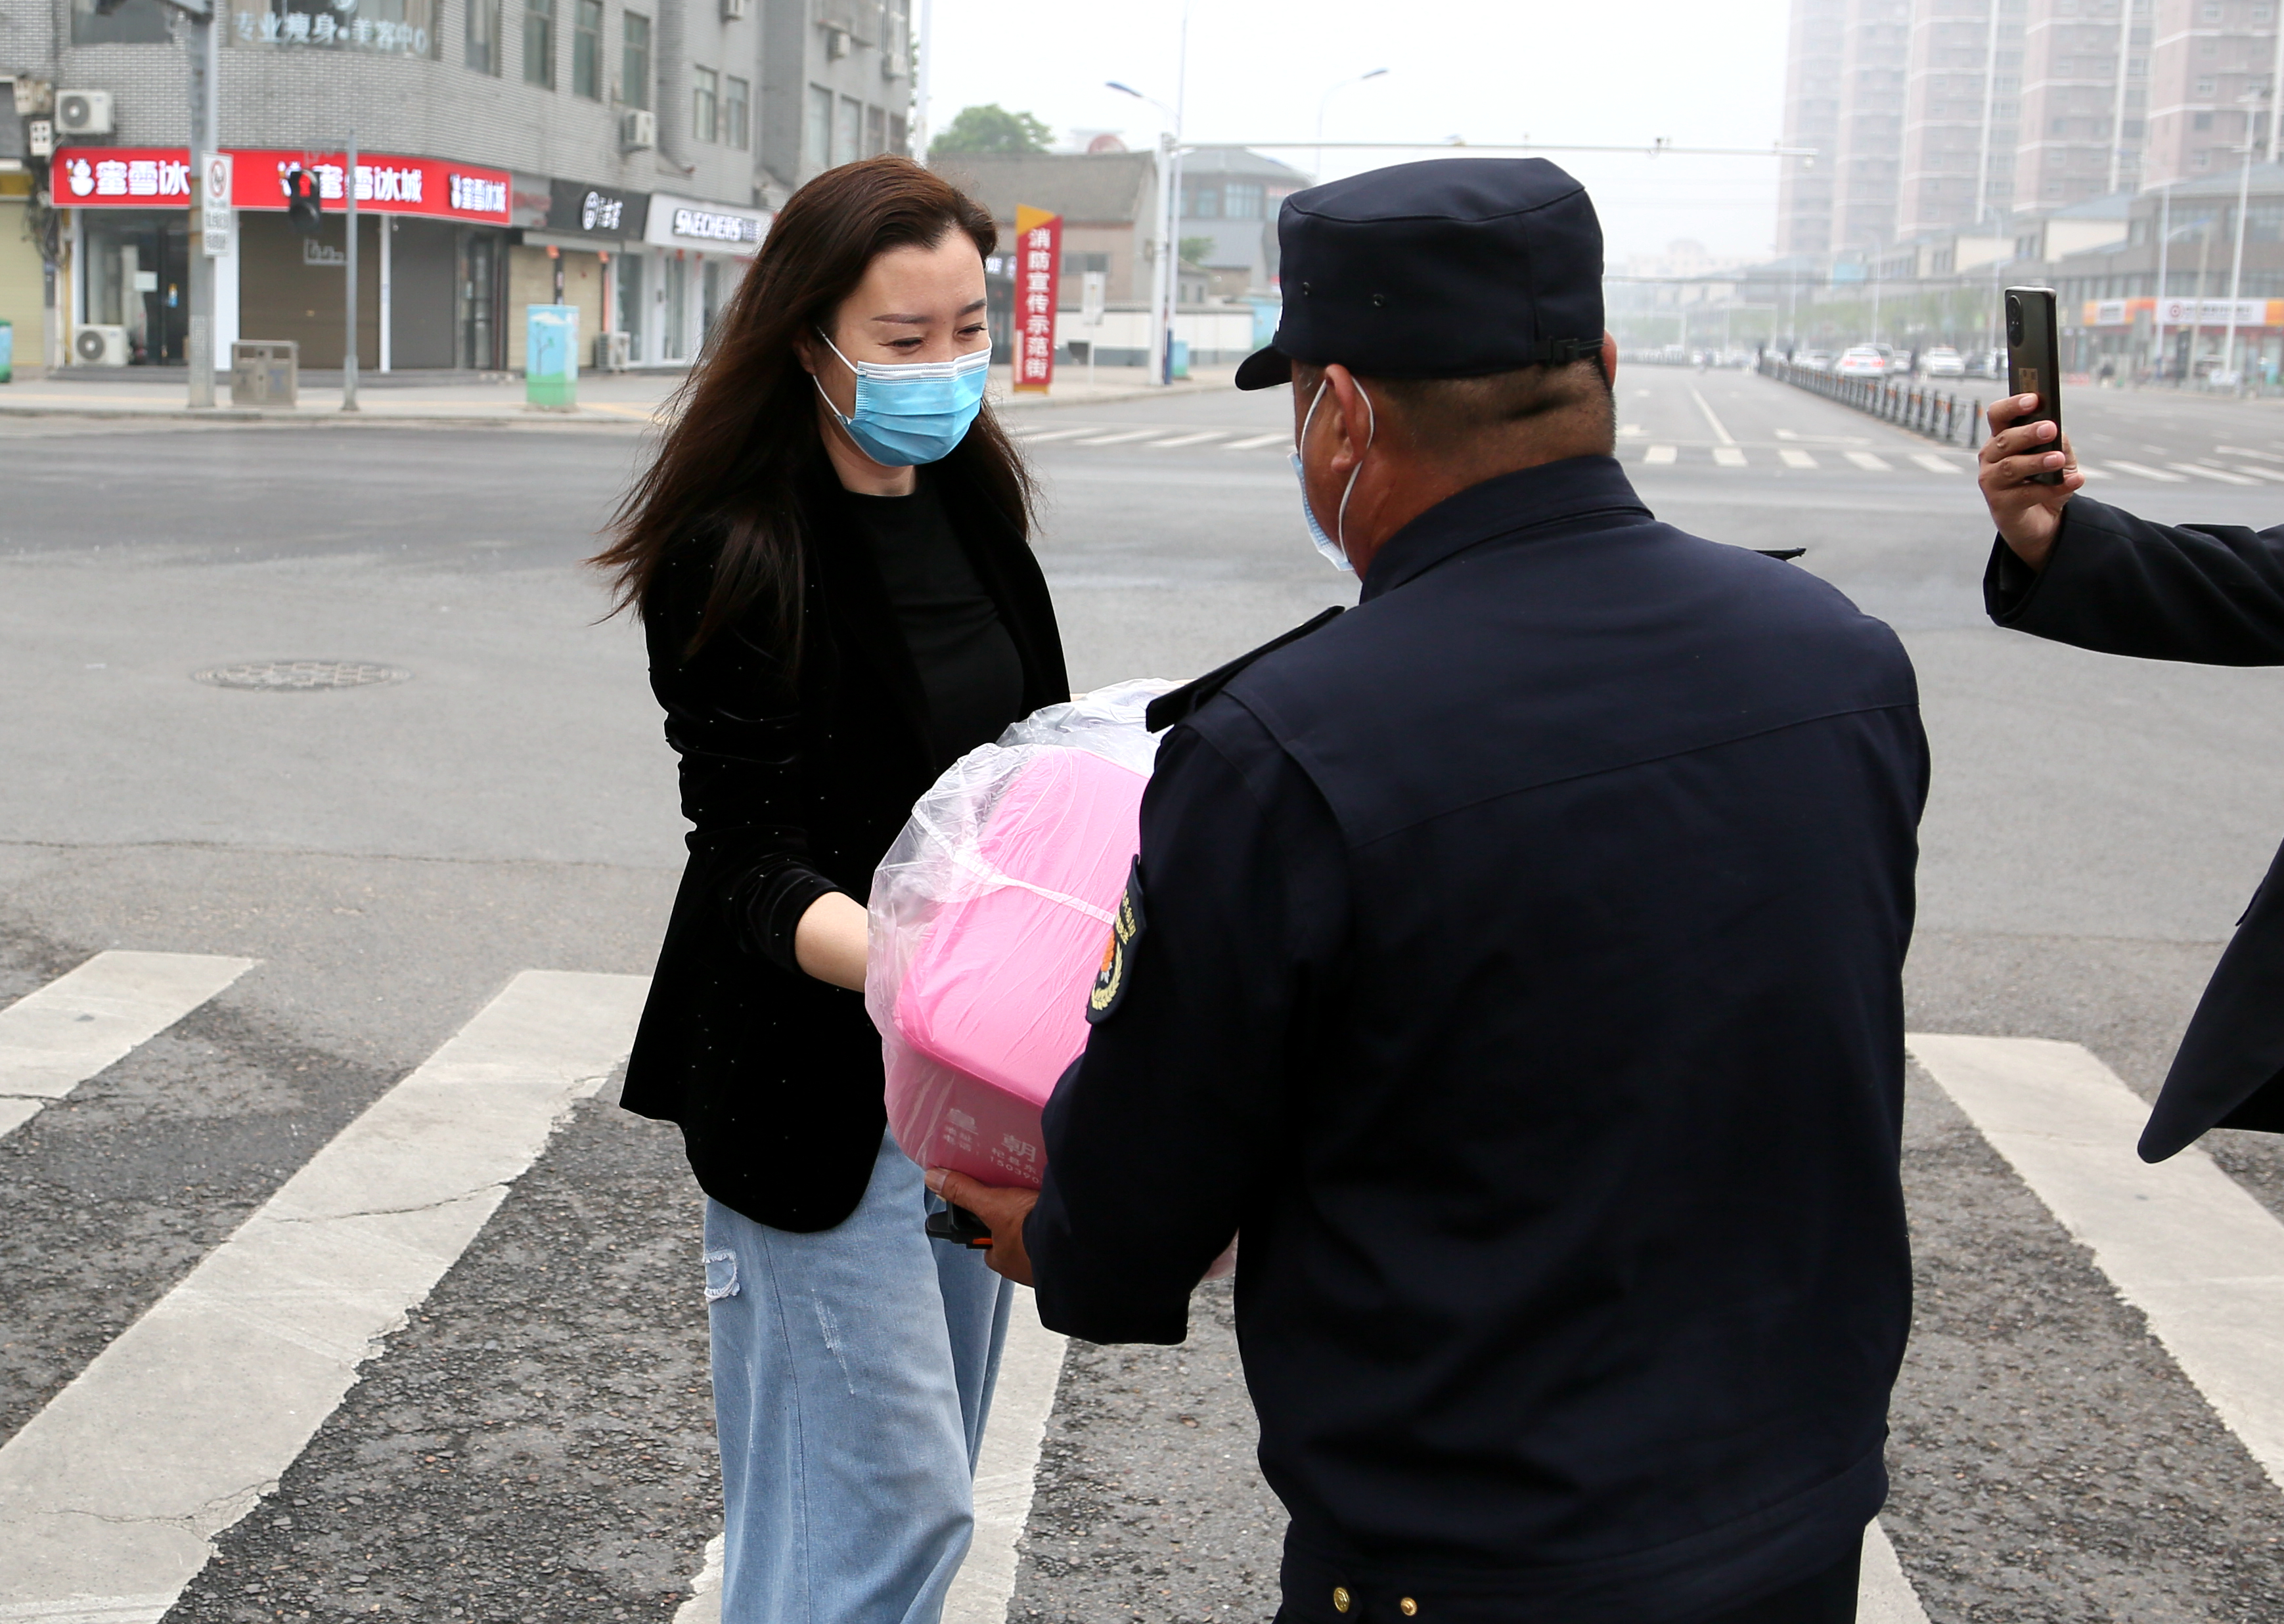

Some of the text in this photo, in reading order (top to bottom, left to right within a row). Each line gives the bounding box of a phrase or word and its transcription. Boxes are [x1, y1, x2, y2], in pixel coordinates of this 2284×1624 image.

[1025, 227, 1051, 379] 消防宣传示范街
